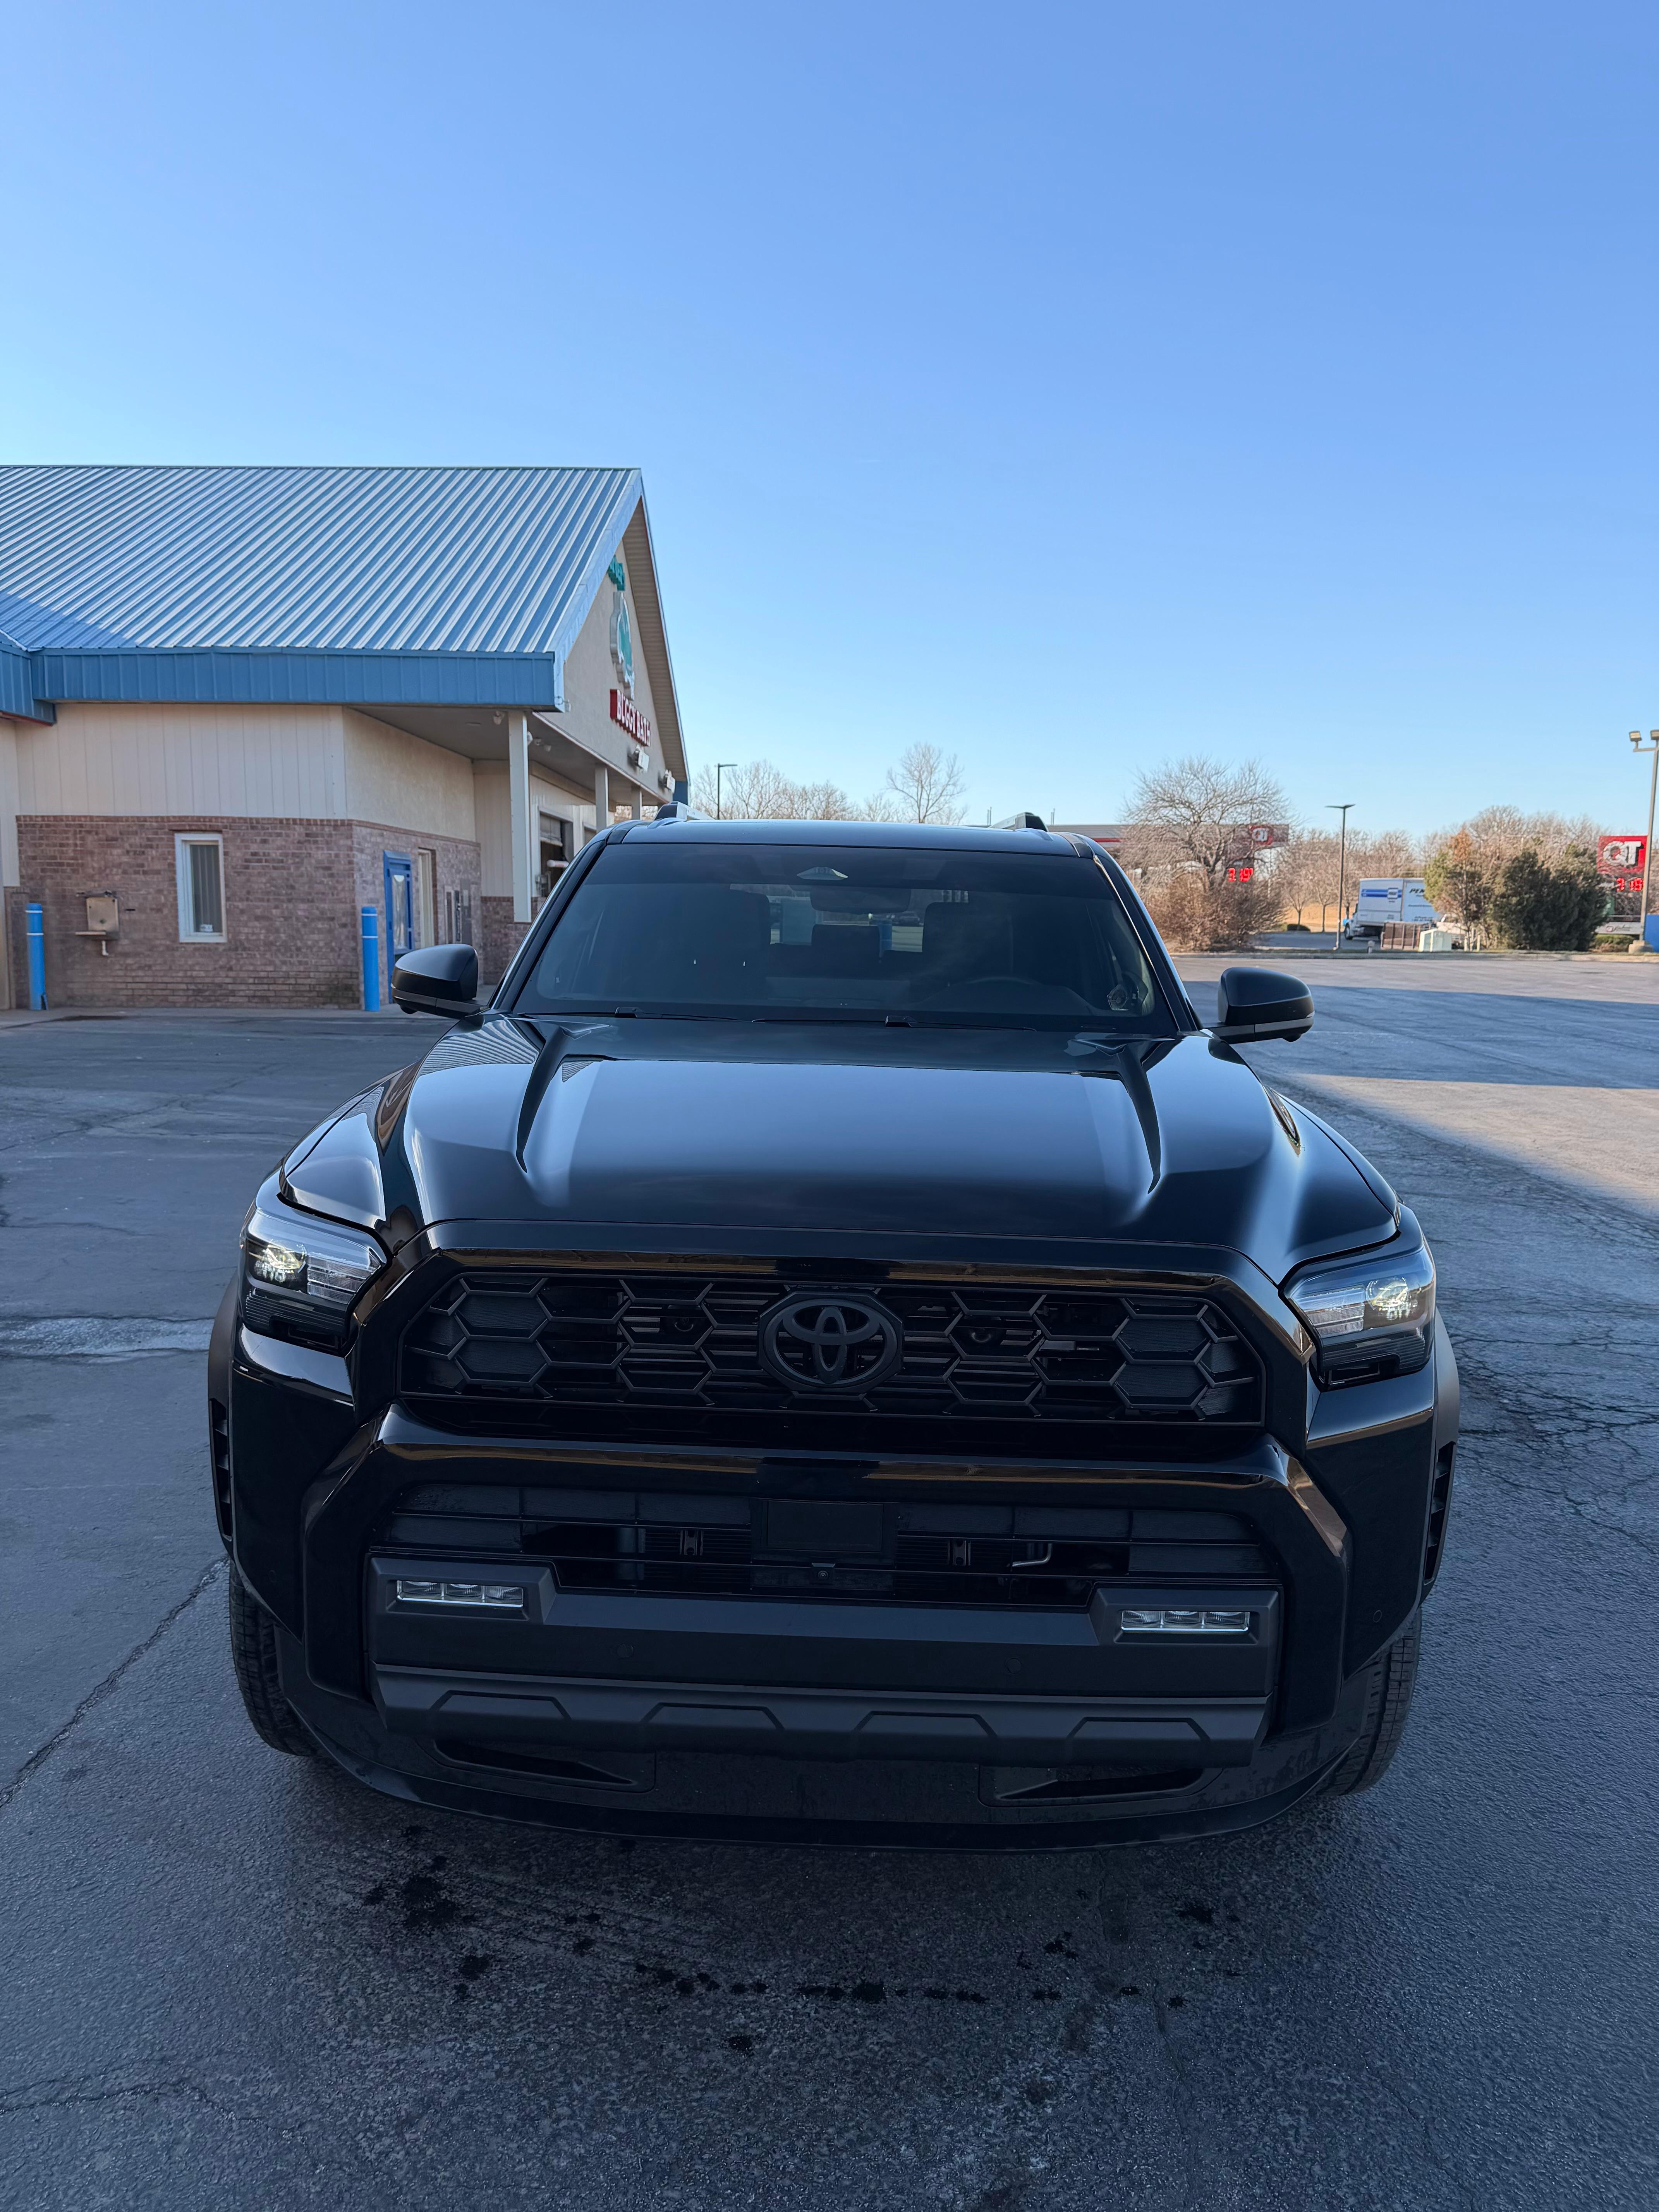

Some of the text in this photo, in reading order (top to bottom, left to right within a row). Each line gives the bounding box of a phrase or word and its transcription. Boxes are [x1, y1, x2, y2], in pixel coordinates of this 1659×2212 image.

[617, 689, 651, 747] BUGGY BATH
[1251, 828, 1269, 842] QT
[1603, 840, 1642, 867] QT
